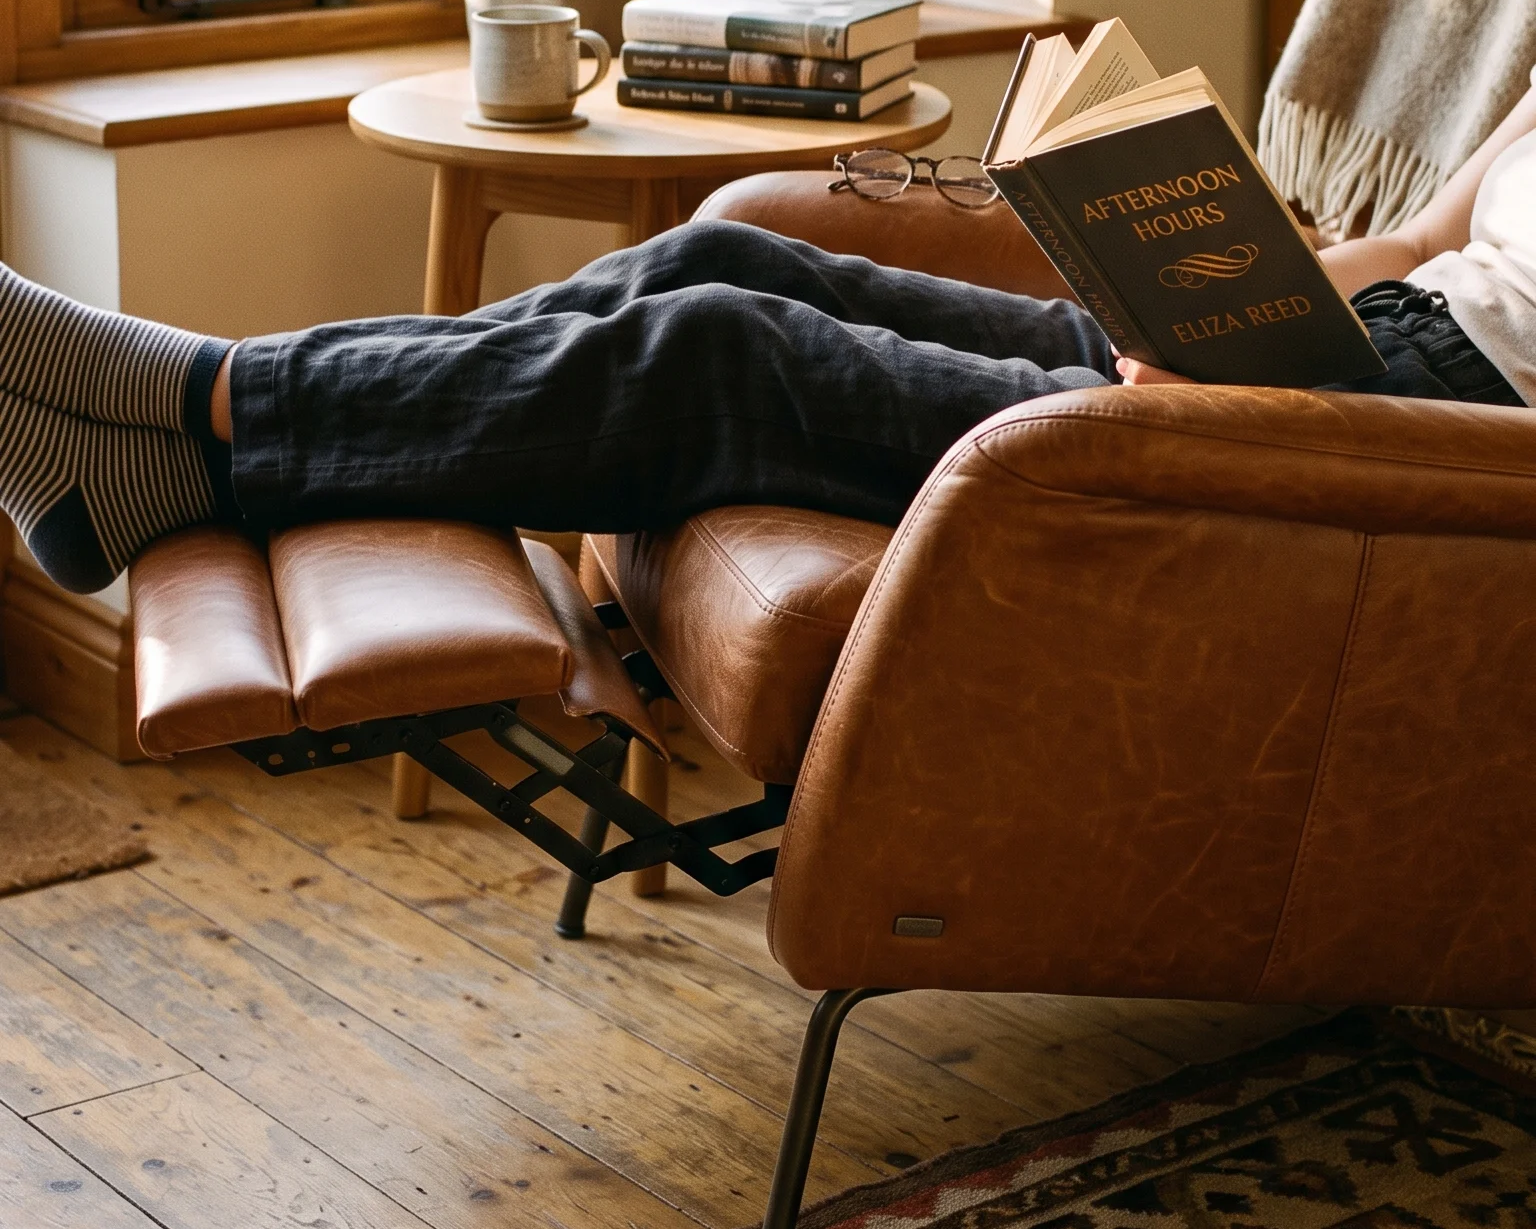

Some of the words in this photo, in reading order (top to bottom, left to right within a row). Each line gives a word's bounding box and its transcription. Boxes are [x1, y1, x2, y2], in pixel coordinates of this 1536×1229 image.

[1083, 163, 1241, 224] AFTERNOON
[1011, 190, 1091, 288] AFTERNOON
[1131, 201, 1226, 242] HOURS
[1171, 312, 1245, 344] ELIZA
[1244, 295, 1312, 327] REED
